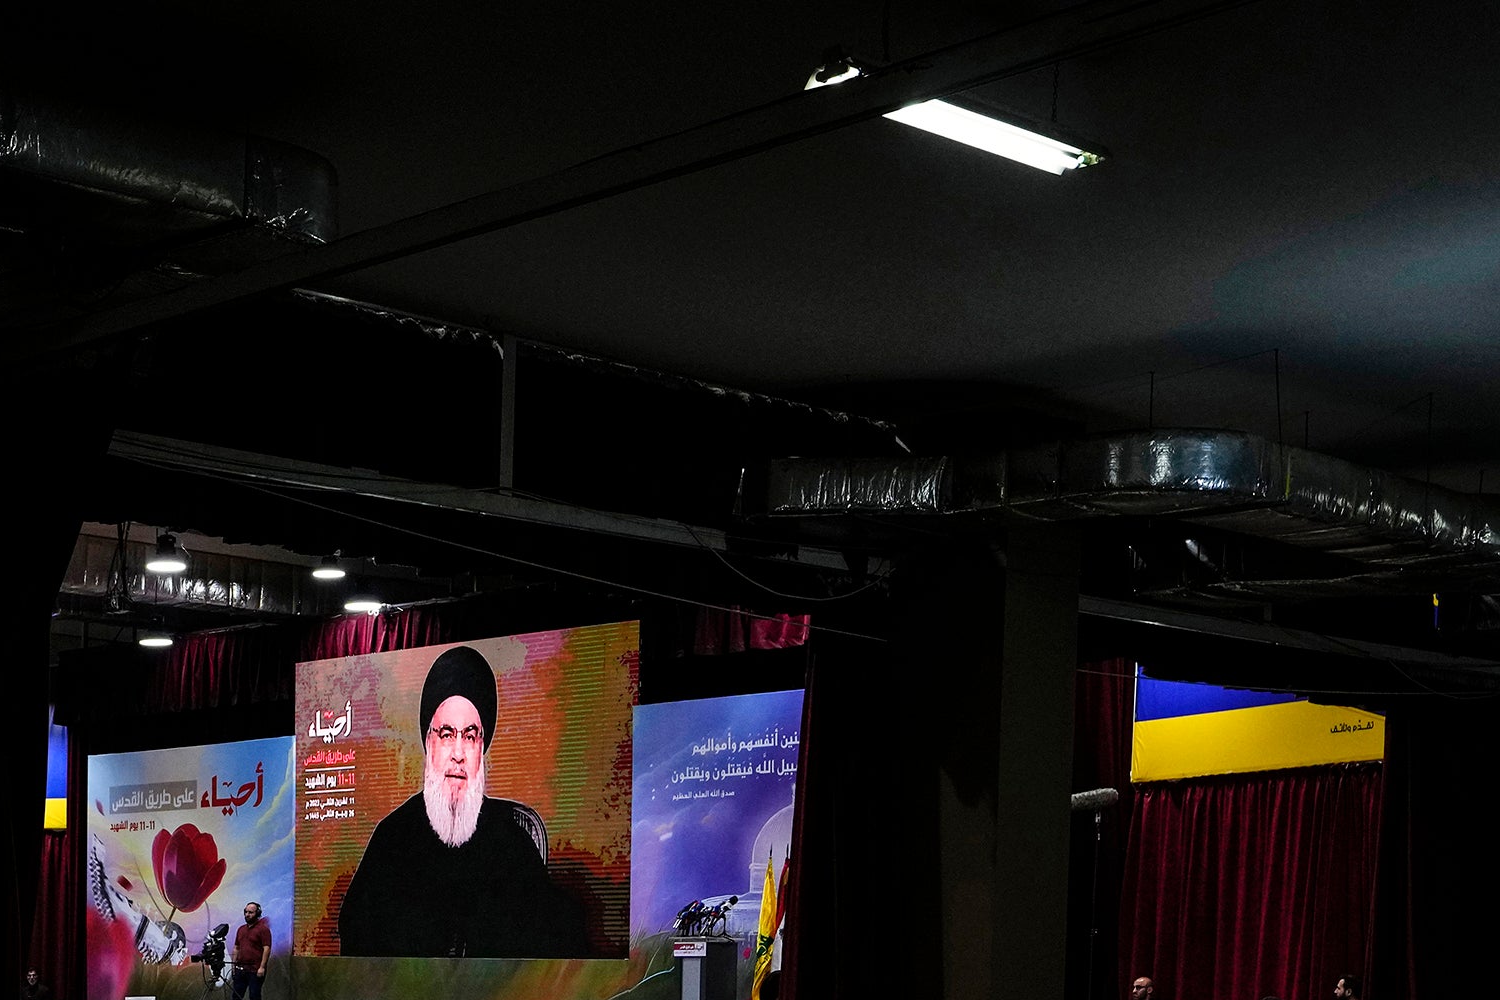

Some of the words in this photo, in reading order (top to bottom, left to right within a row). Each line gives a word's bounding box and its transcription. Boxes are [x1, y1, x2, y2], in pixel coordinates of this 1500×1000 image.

[304, 750, 325, 766] القدس
[325, 749, 342, 764] طريق
[342, 748, 356, 763] على
[304, 773, 326, 789] الشهيد
[326, 775, 337, 788] يوم
[112, 791, 144, 812] القدس
[145, 789, 171, 809] طريق
[173, 787, 195, 807] على
[110, 820, 129, 832] الشهيد
[129, 822, 139, 832] يوم
[140, 820, 155, 831] 11-11
